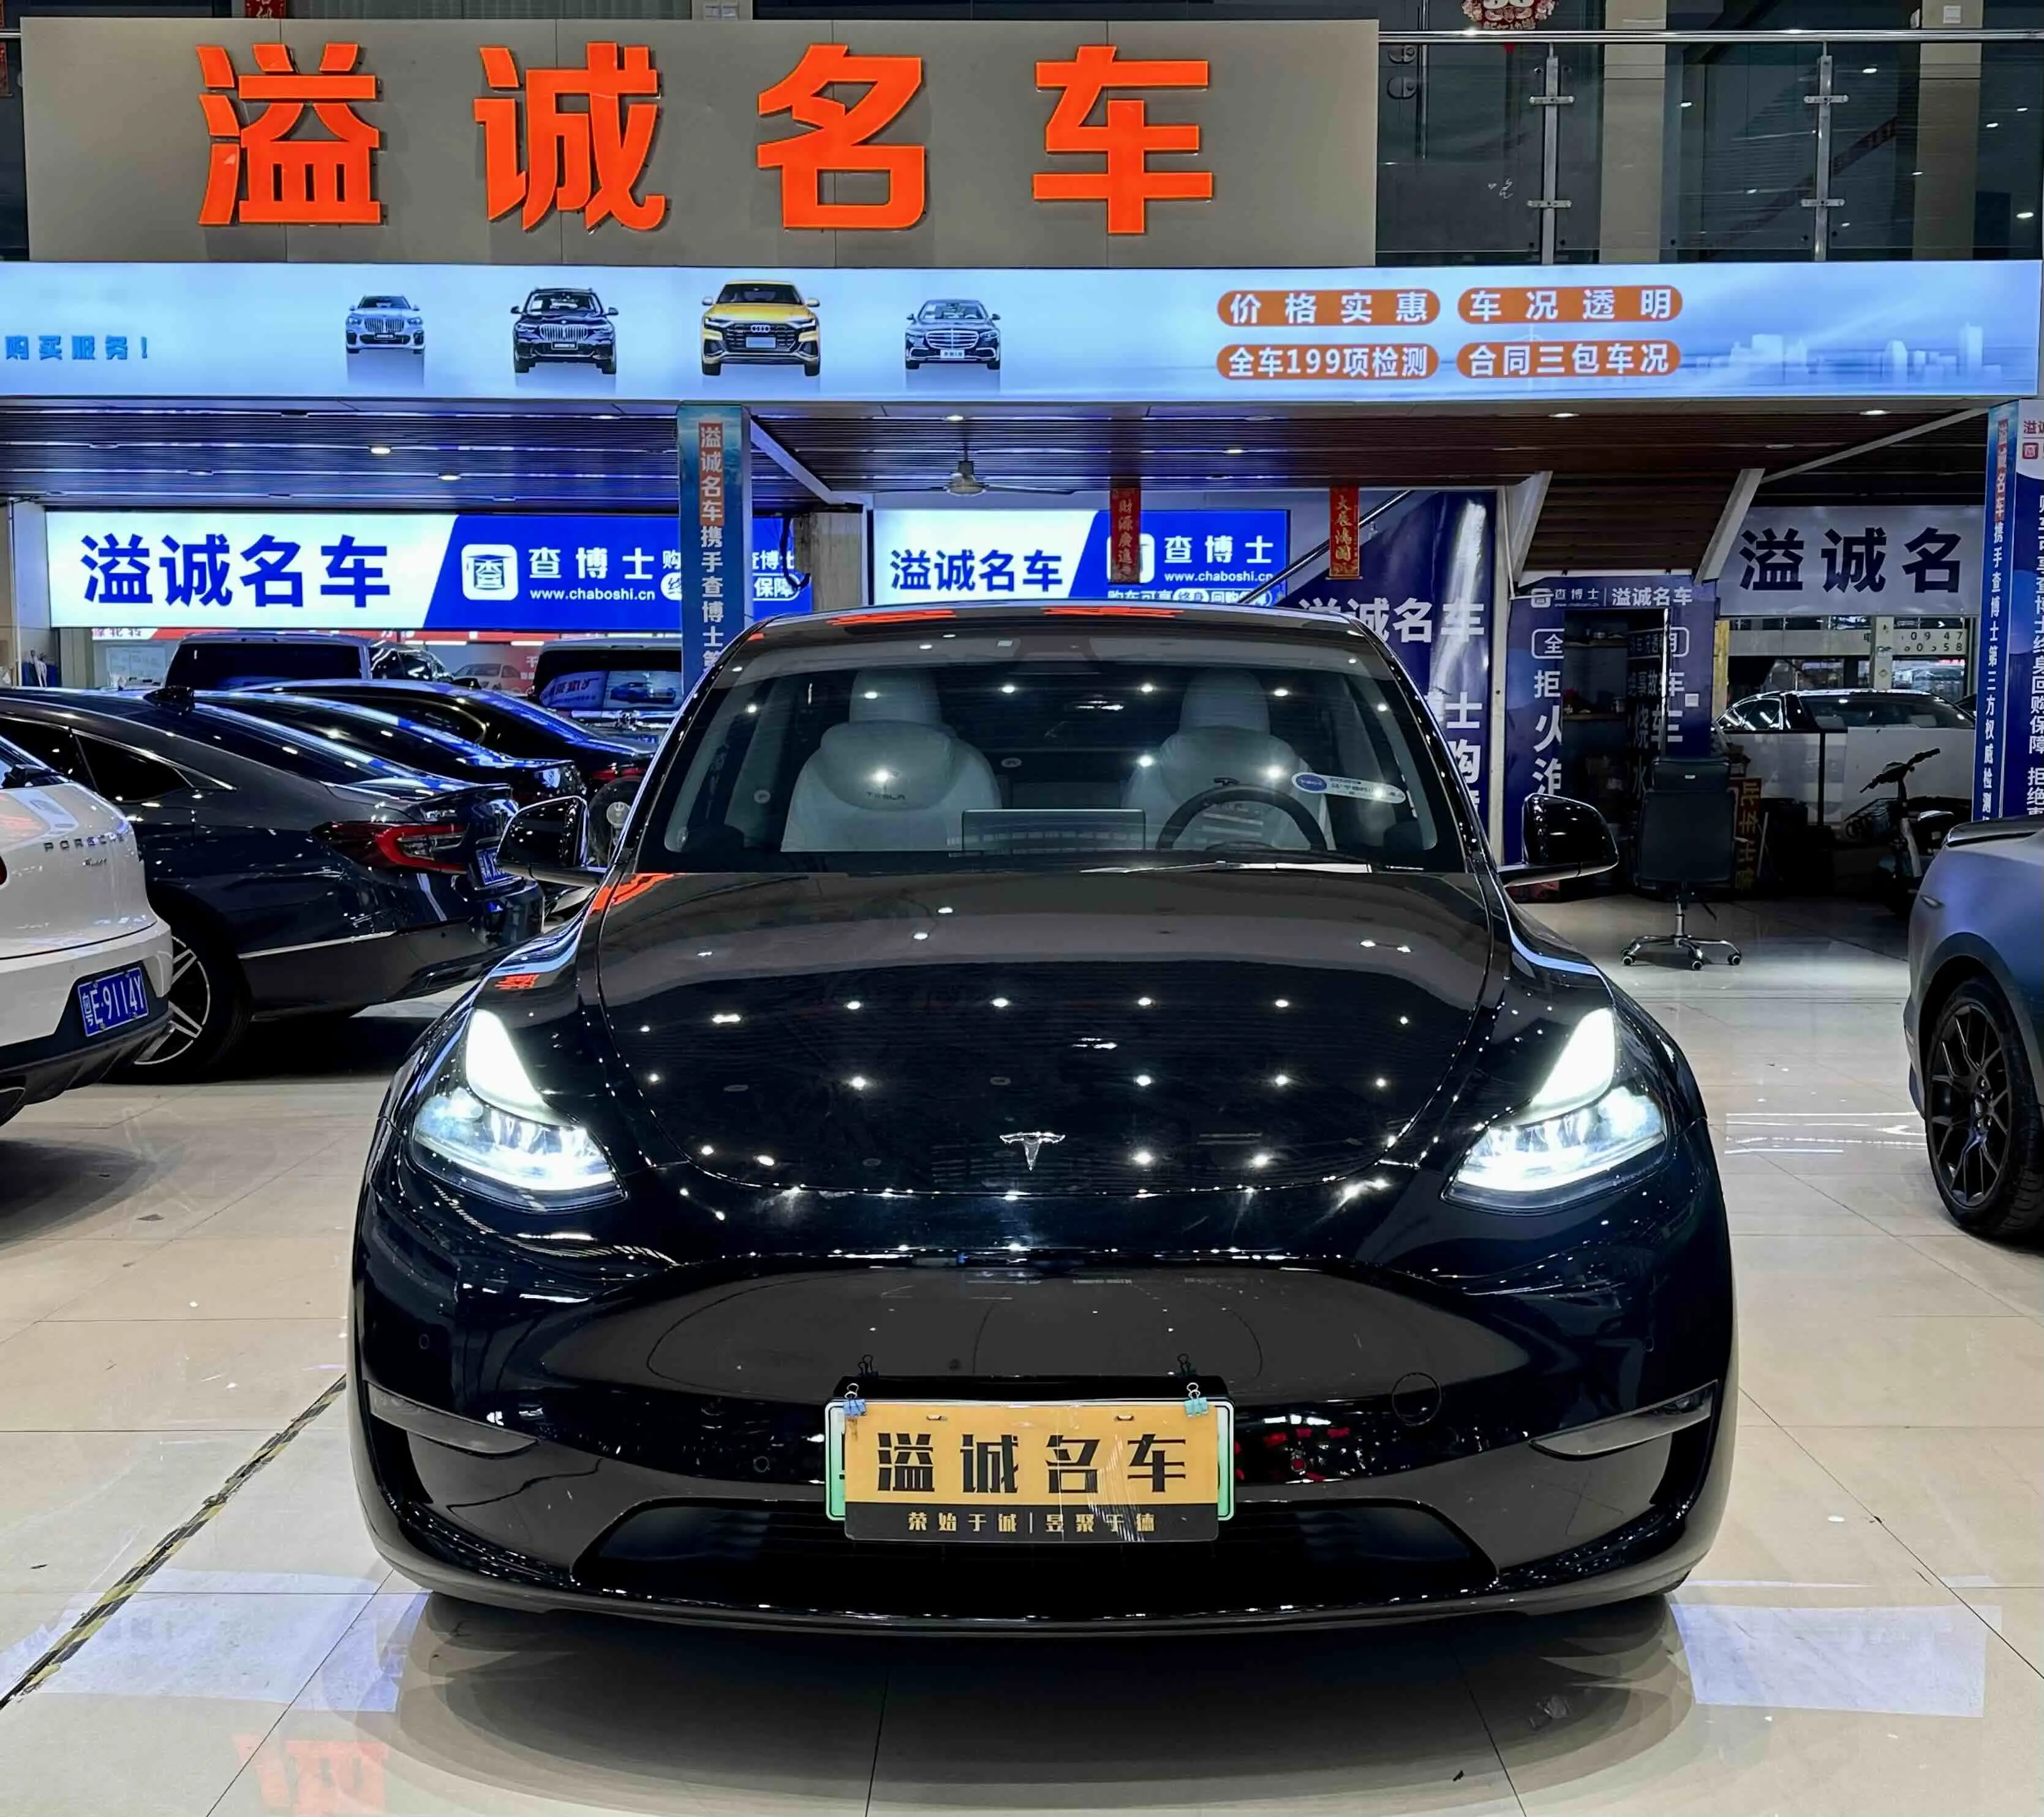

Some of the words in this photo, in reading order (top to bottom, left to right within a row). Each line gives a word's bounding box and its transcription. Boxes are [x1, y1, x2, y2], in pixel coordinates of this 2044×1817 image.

[197, 42, 1213, 234] 溢诚名车
[1230, 292, 1428, 325] 价格实惠
[1469, 290, 1673, 321] 车况透明
[1228, 346, 1427, 377] 全车199项检测
[1469, 343, 1669, 377] 合同三包车况
[529, 547, 655, 580] 查博士
[1164, 535, 1274, 564] 查博士
[1739, 527, 1962, 594] 溢诚名
[80, 533, 390, 608] 溢诚名车
[889, 549, 1063, 592] 溢诚名车
[530, 586, 655, 601] www.chaboshi.cn
[1555, 588, 1599, 600] 查博士
[1612, 586, 1692, 606] 溢诚名车
[878, 1432, 1186, 1494] 溢诚名车
